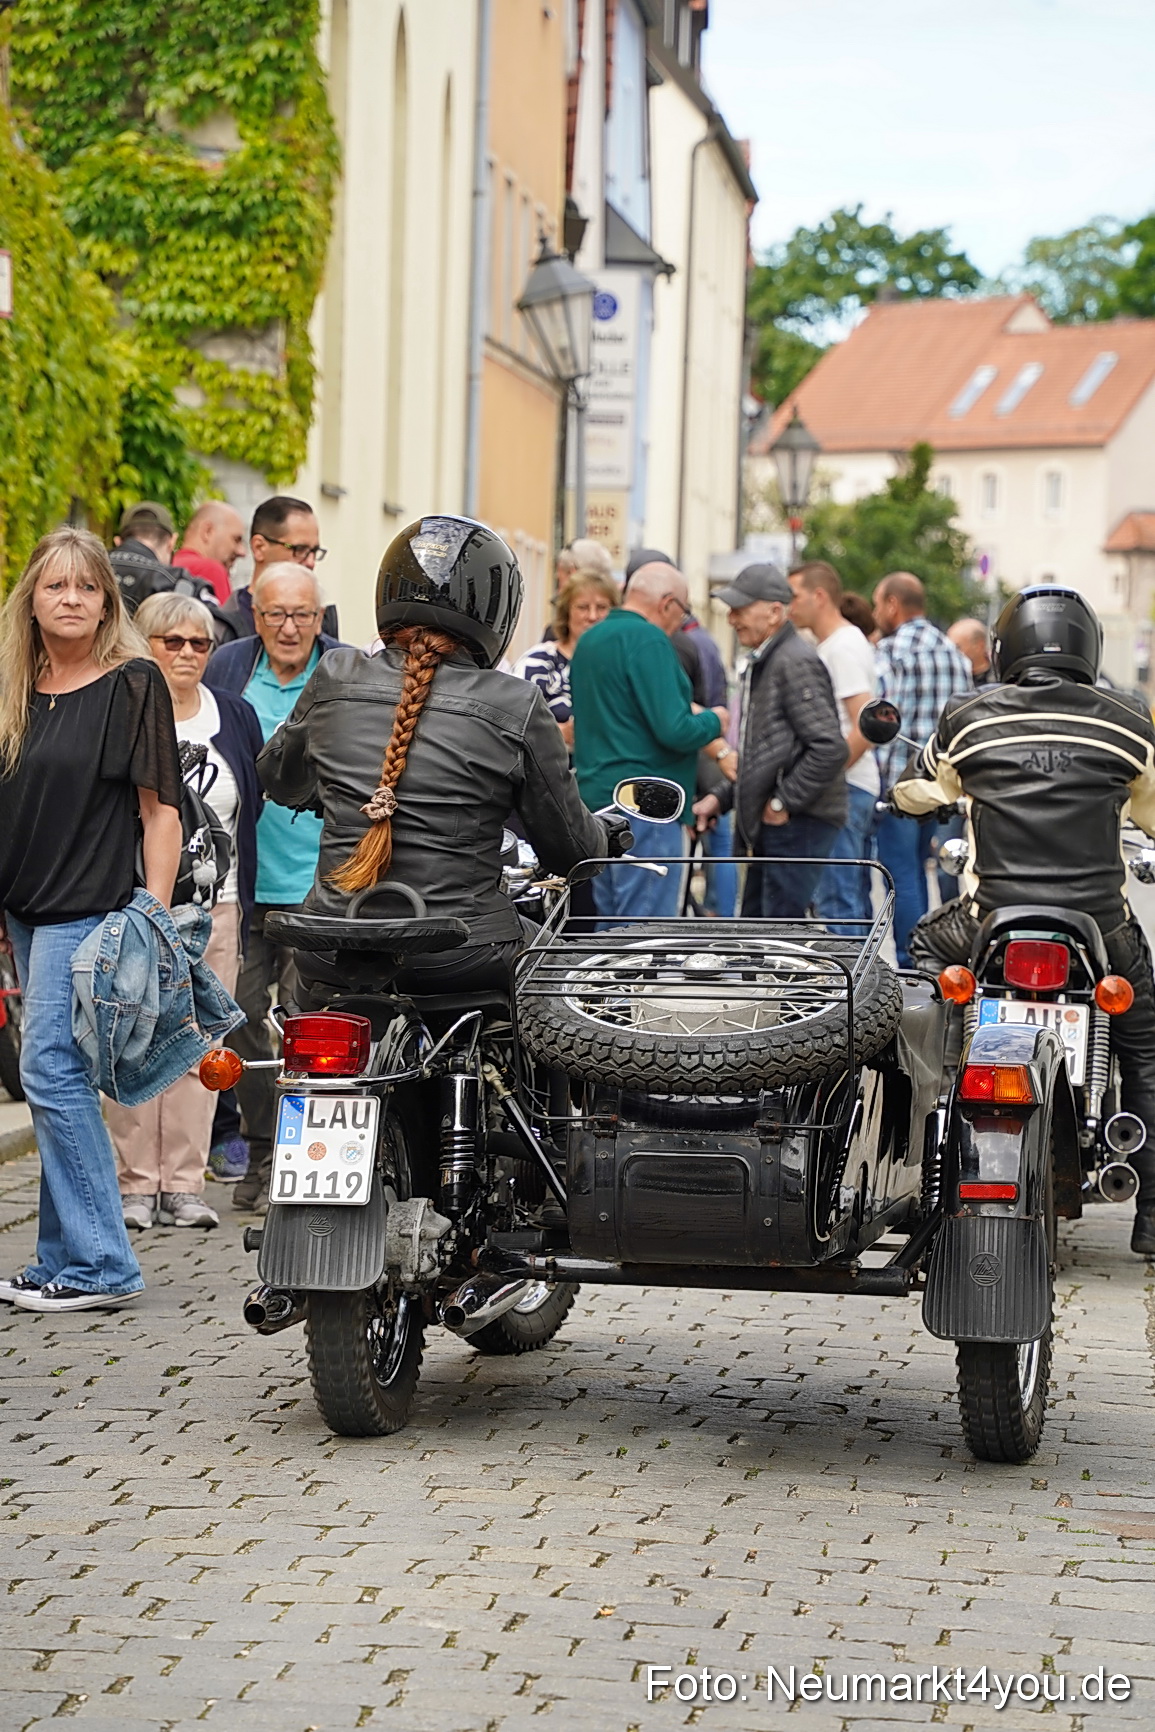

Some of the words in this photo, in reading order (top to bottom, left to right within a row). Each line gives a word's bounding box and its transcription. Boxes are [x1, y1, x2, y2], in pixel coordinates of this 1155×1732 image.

[307, 1100, 371, 1130] LAU
[284, 1126, 296, 1140] D
[277, 1170, 363, 1199] D119
